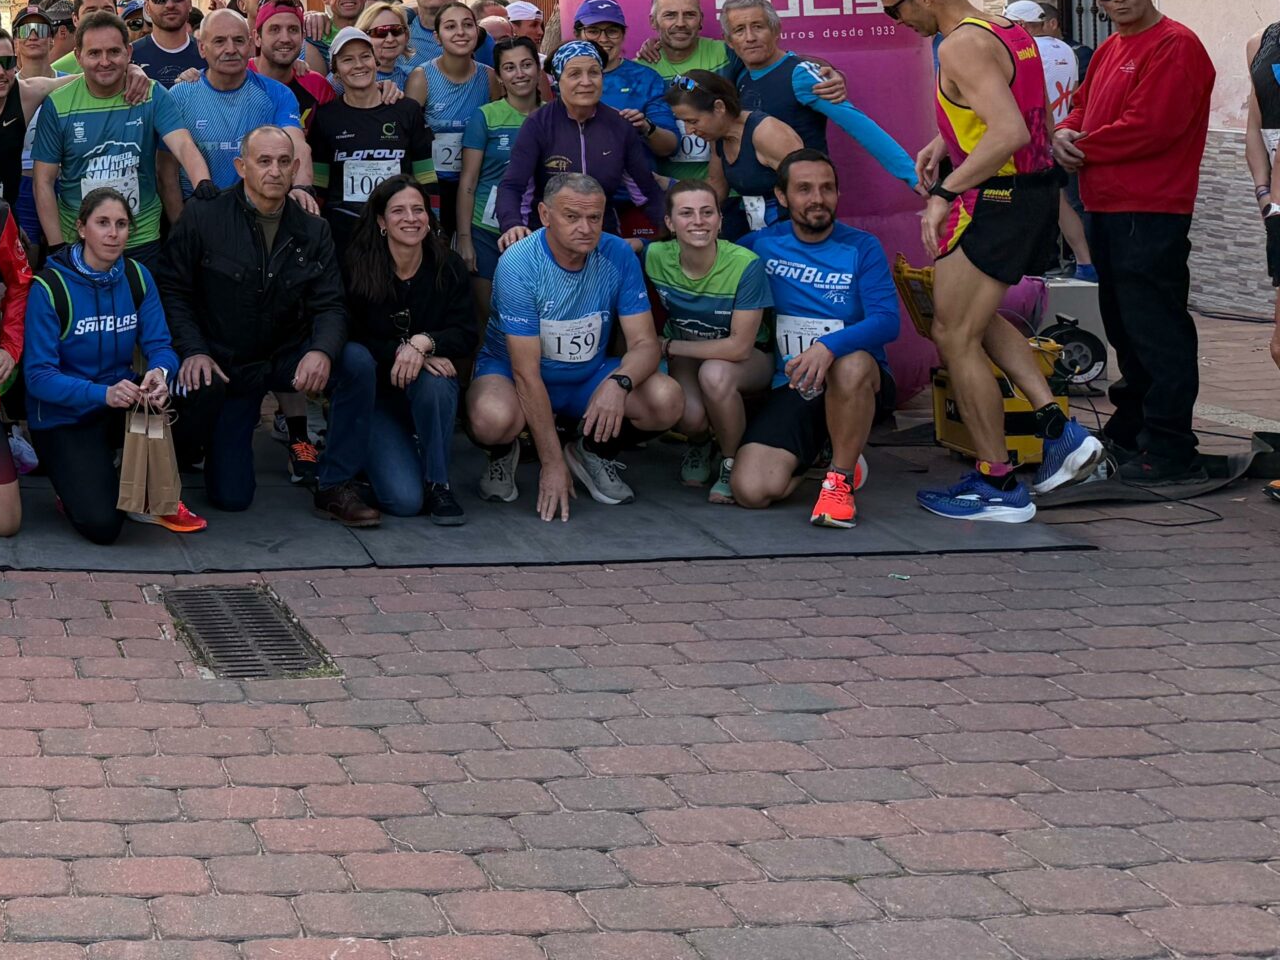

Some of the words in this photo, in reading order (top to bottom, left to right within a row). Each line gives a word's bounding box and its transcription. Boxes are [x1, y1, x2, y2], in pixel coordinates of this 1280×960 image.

[780, 30, 815, 40] uros
[822, 27, 864, 39] desde
[871, 25, 896, 36] 1933
[681, 135, 708, 155] 09
[86, 154, 112, 172] XXV
[111, 151, 132, 163] VUELTA
[555, 332, 596, 356] 159
